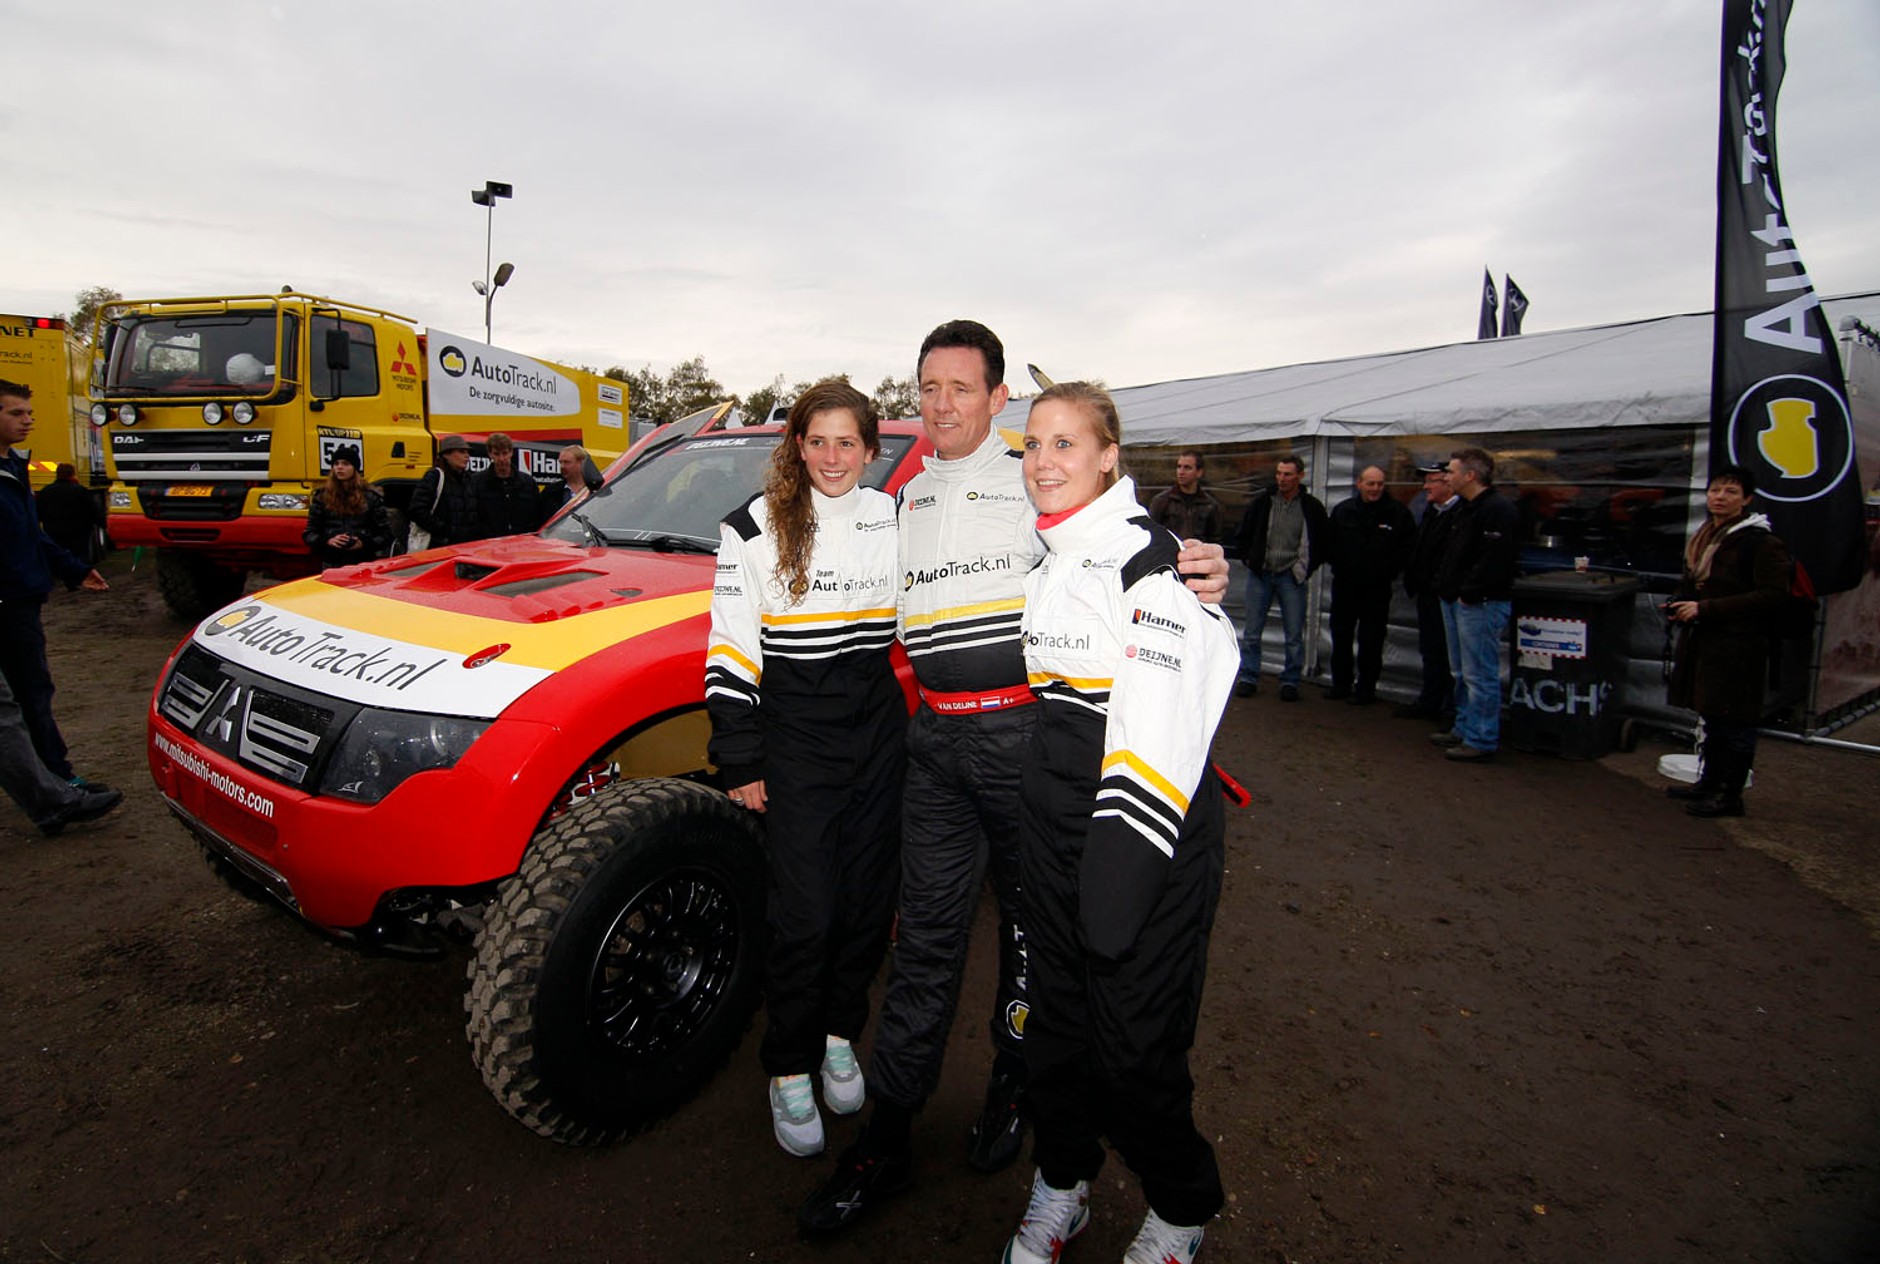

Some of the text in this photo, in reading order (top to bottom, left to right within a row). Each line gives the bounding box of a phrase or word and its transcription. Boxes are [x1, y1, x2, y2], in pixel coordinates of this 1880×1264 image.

[471, 356, 557, 394] AutoTrack.nl
[469, 386, 482, 399] De
[483, 391, 526, 409] zorgvuldige
[915, 554, 1011, 585] AutoTrack.nl
[1141, 611, 1186, 634] Hamer
[229, 615, 448, 691] AutoTrack.nl
[155, 732, 275, 819] www.mitsubishi-motors.com
